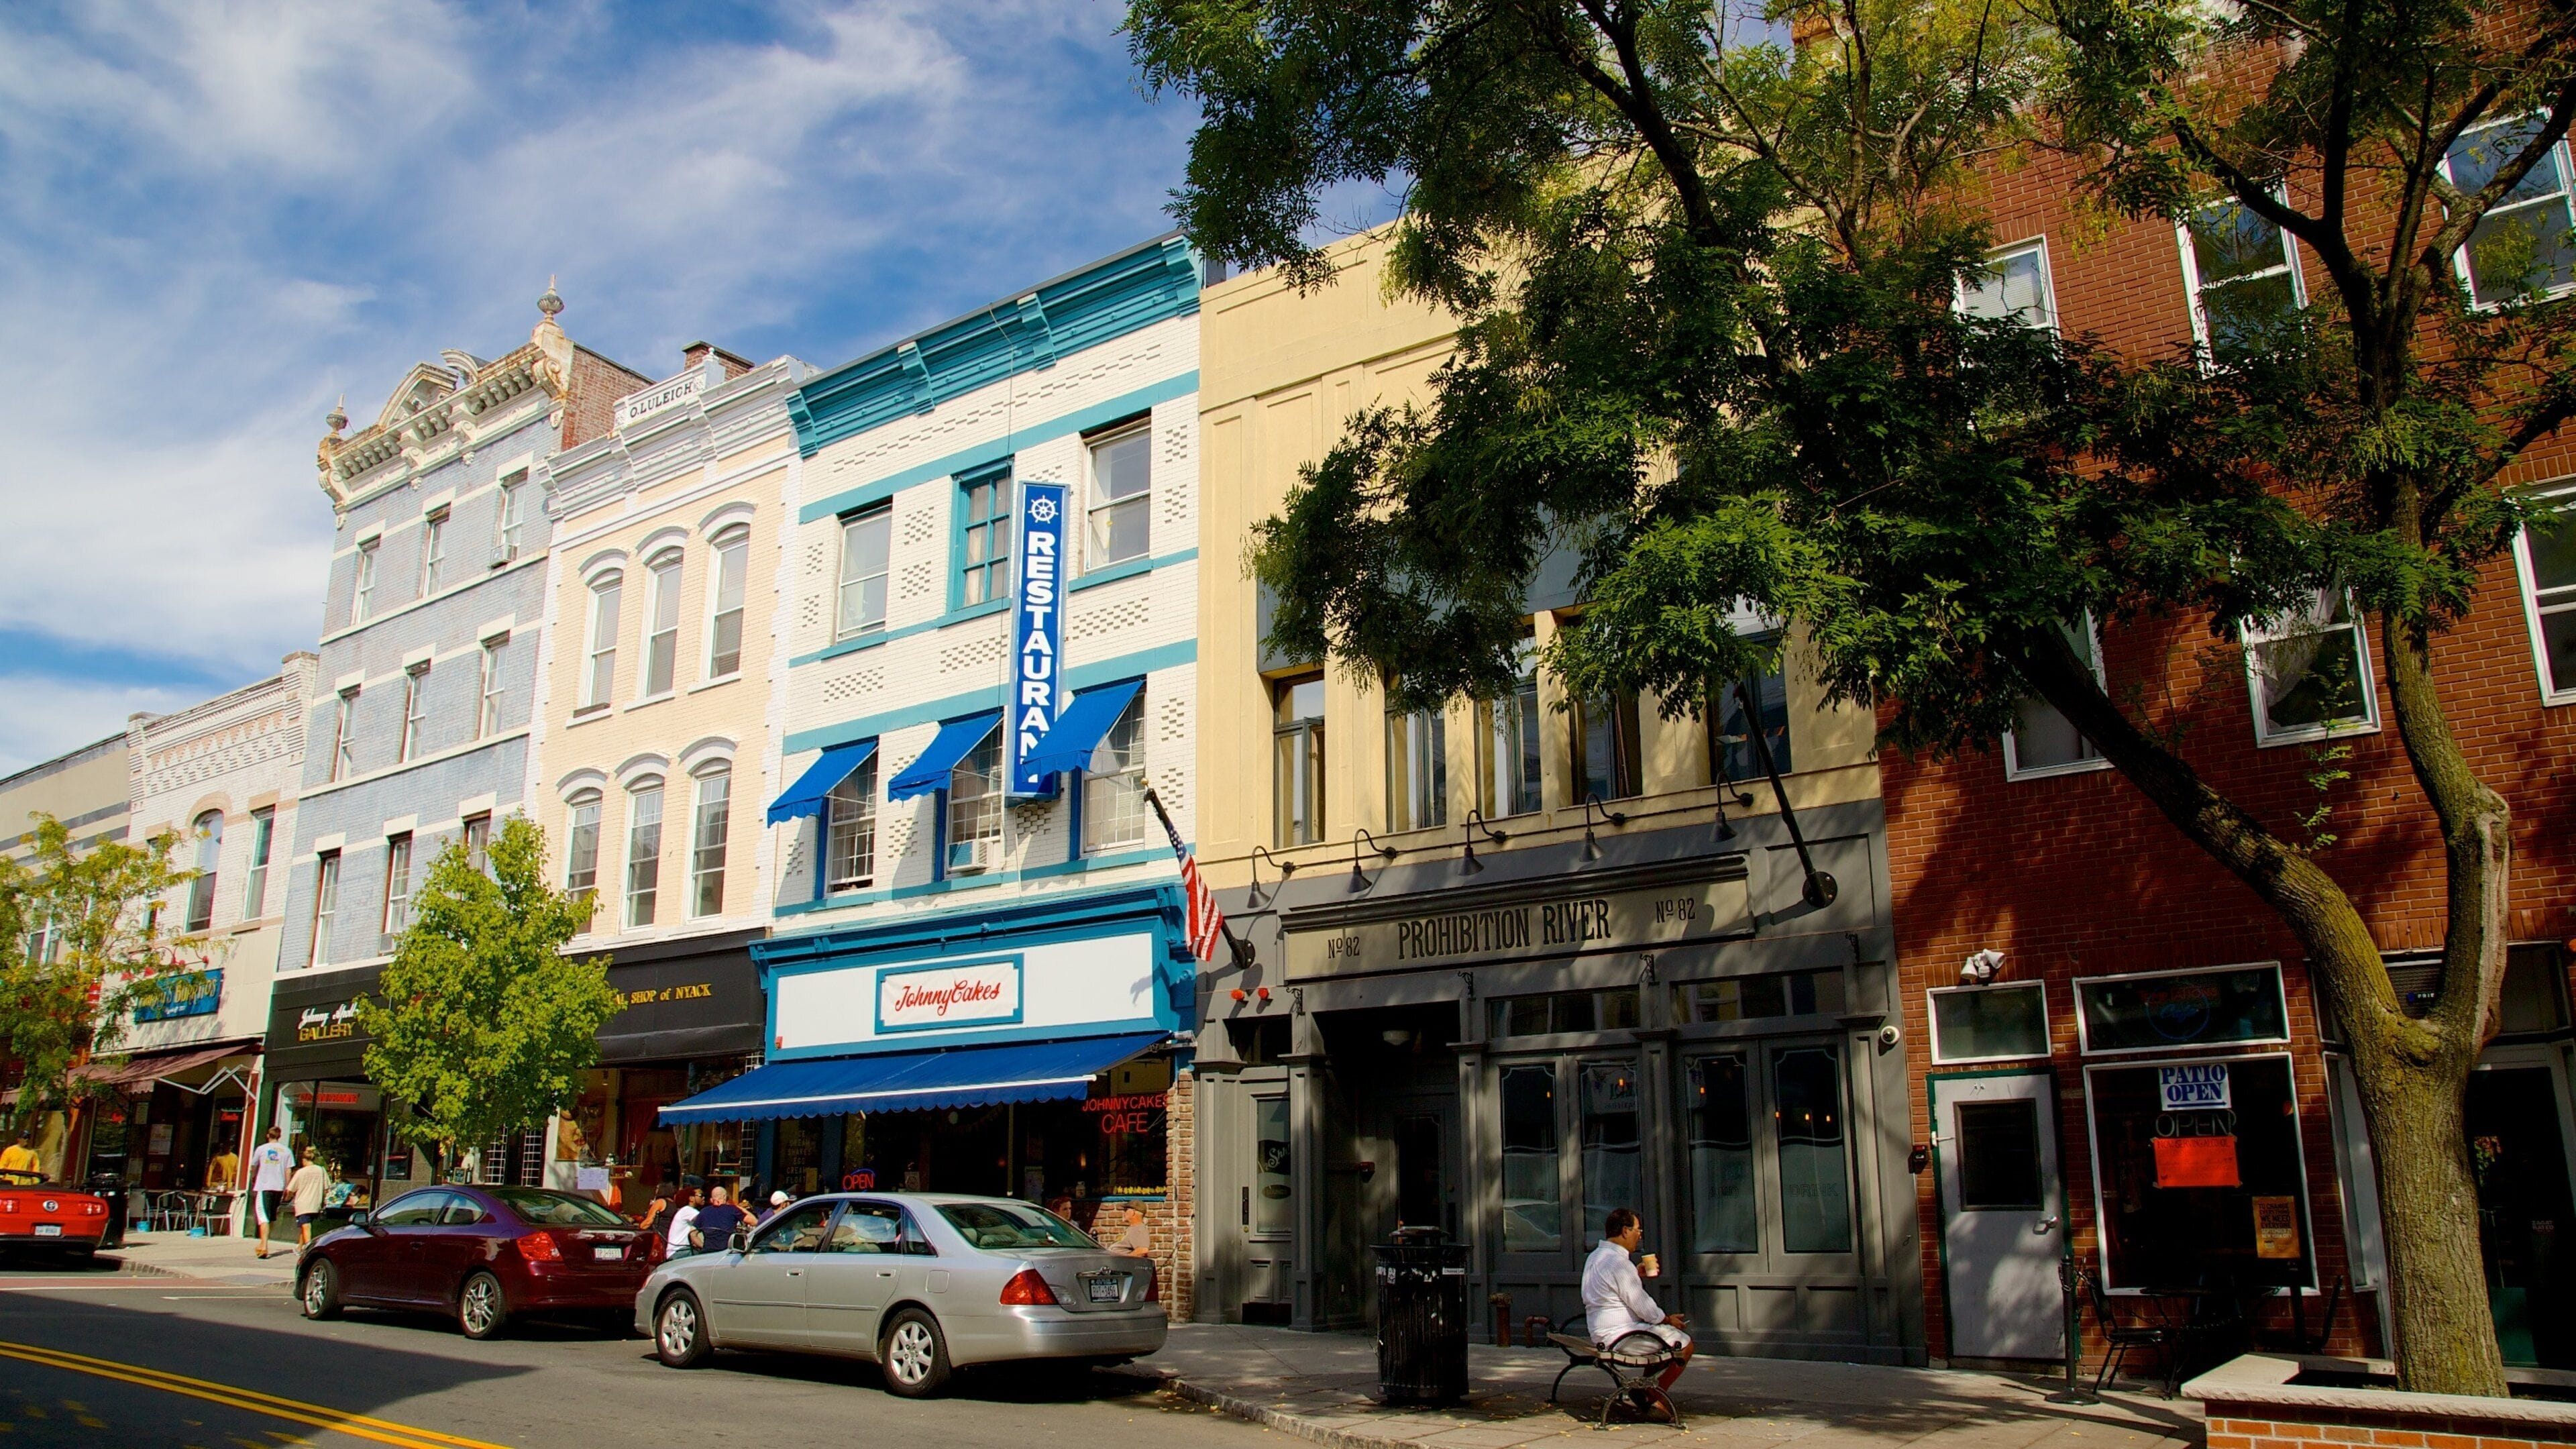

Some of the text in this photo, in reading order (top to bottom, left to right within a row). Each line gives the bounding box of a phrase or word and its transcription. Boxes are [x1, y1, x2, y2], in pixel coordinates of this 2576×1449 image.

[1018, 530, 1057, 783] RESTAURAN
[1678, 897, 1696, 921] 82
[1397, 899, 1611, 960] PROHIBITION RIVER
[1346, 936, 1360, 957] 82
[631, 989, 657, 1004] SHOP
[659, 987, 672, 1001] of
[676, 983, 712, 1000] NYACK
[895, 979, 1001, 1016] JohnnyCakes
[299, 1021, 356, 1042] GALLERY
[2161, 1064, 2227, 1085] PATIO
[2167, 1082, 2223, 1102] OPEN
[1101, 1112, 1149, 1134] CAFE
[2155, 1112, 2233, 1138] OPEN
[843, 1173, 875, 1191] OPEN
[1788, 1183, 1839, 1199] DRINK
